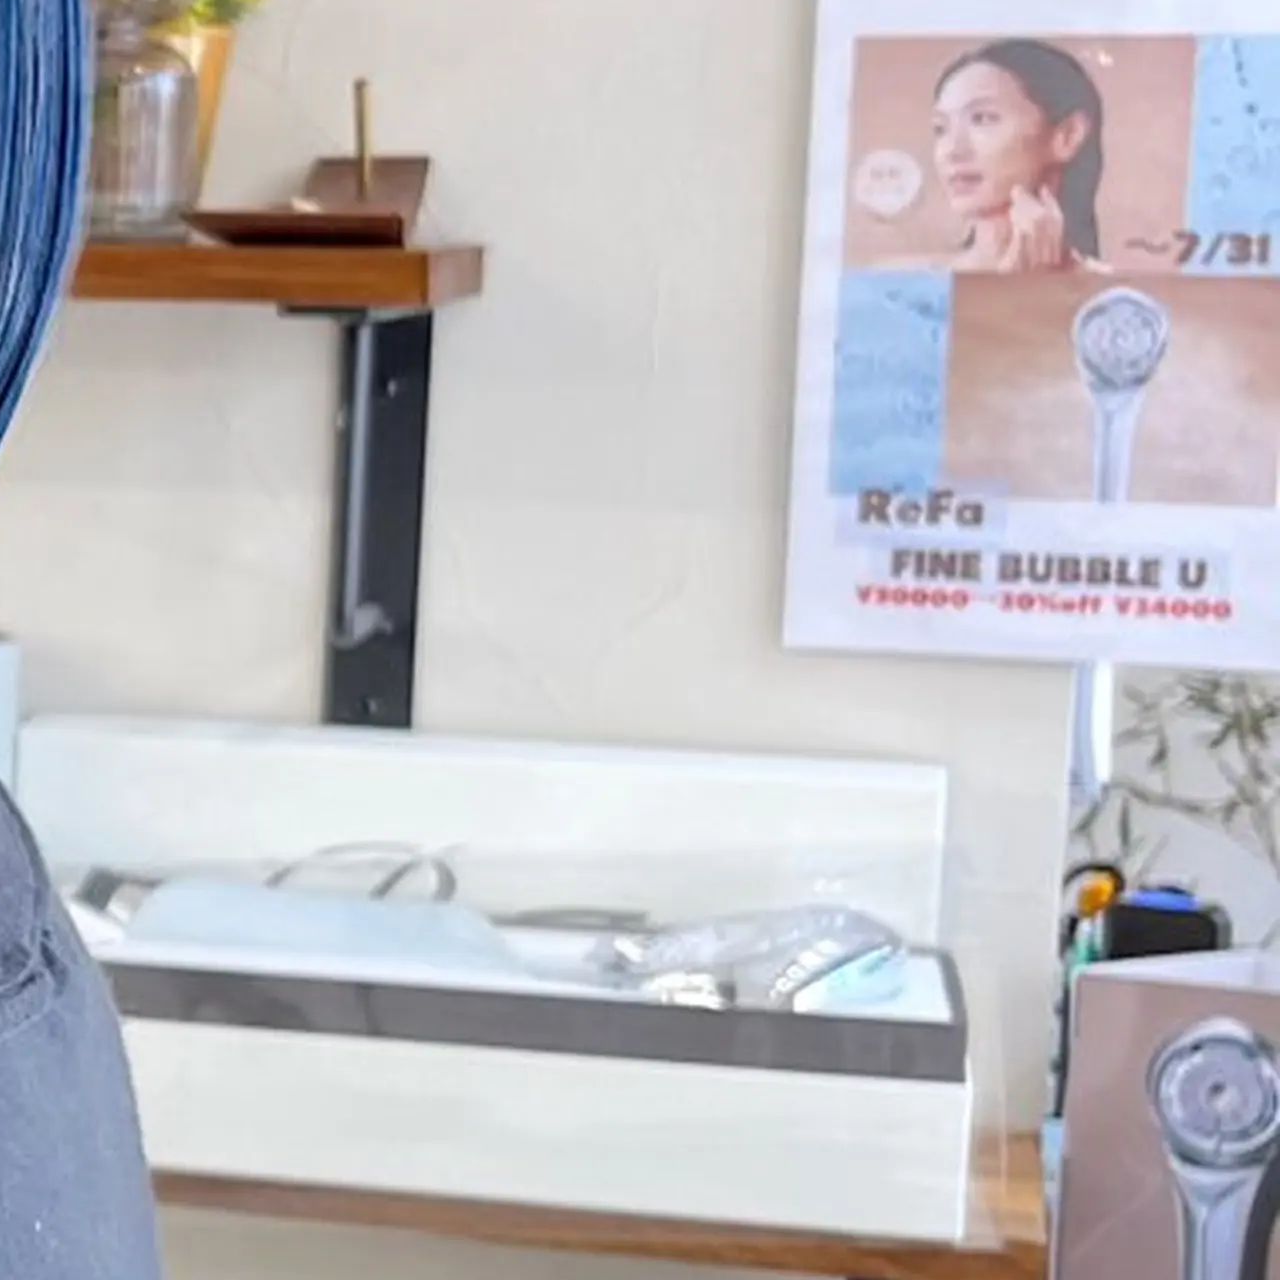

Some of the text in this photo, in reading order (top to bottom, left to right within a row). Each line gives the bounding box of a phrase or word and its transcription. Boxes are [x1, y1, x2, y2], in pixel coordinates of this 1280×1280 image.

[856, 488, 985, 527] ReFa
[890, 548, 1208, 589] FINE BUBBLE U
